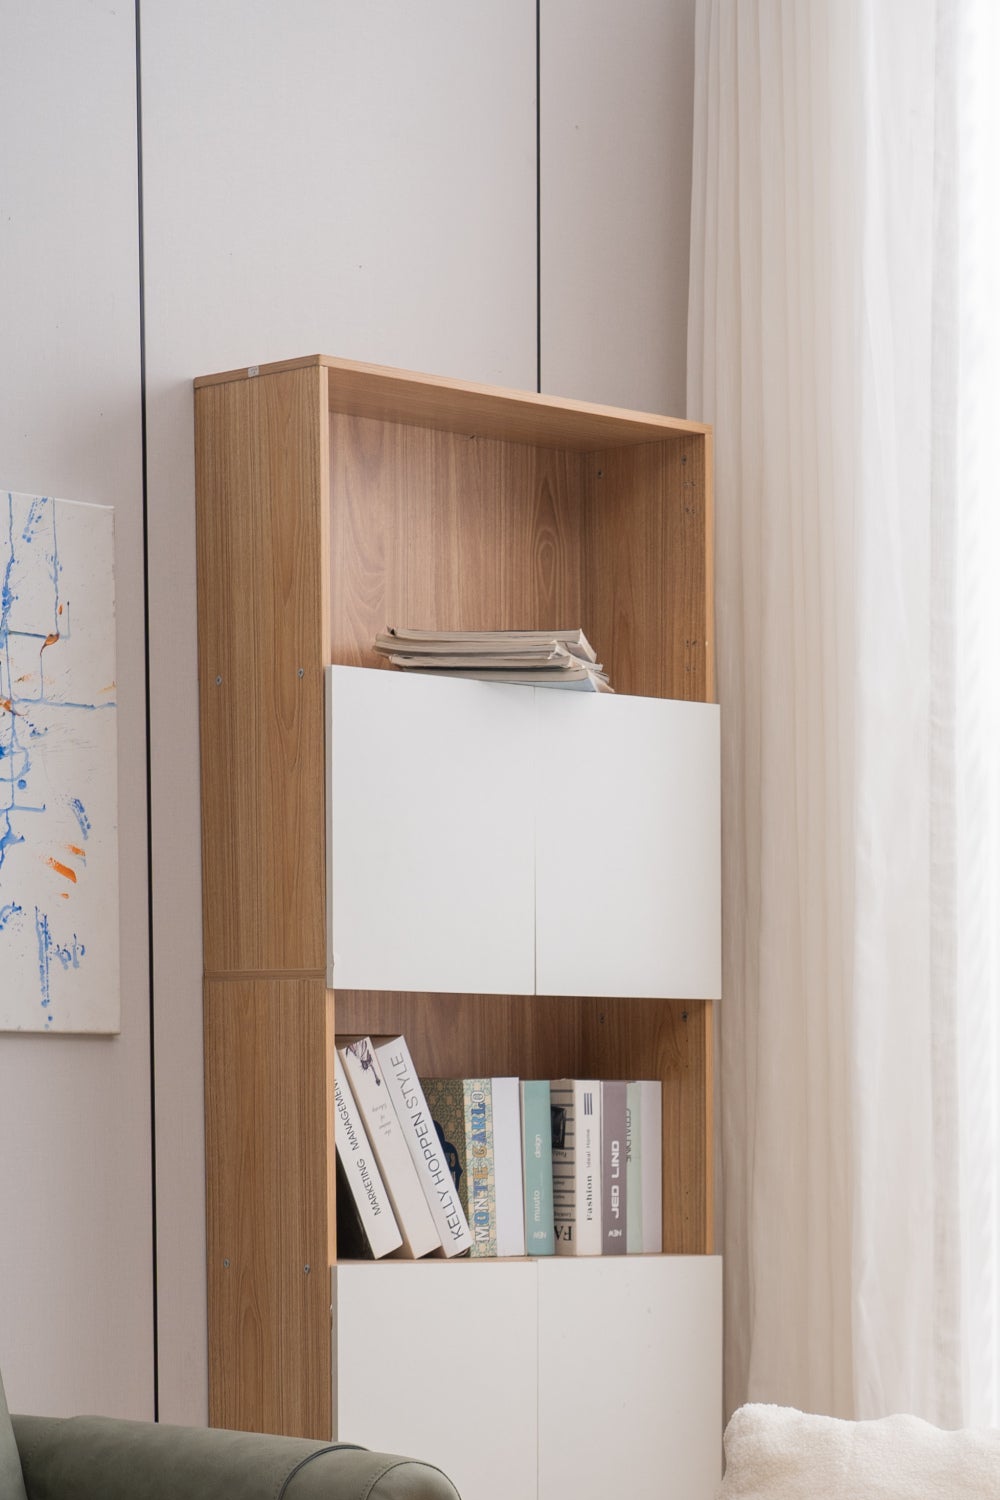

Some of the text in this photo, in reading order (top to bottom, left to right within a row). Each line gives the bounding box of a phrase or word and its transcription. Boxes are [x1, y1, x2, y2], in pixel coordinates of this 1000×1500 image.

[334, 1079, 360, 1151] MANAGEMEN
[390, 1052, 465, 1241] KELLY HOPPEN STYLE
[356, 1158, 382, 1216] MARKETING
[471, 1091, 490, 1243] MONTE CARLO
[611, 1140, 620, 1219] JED LIND
[533, 1190, 541, 1222] muuto
